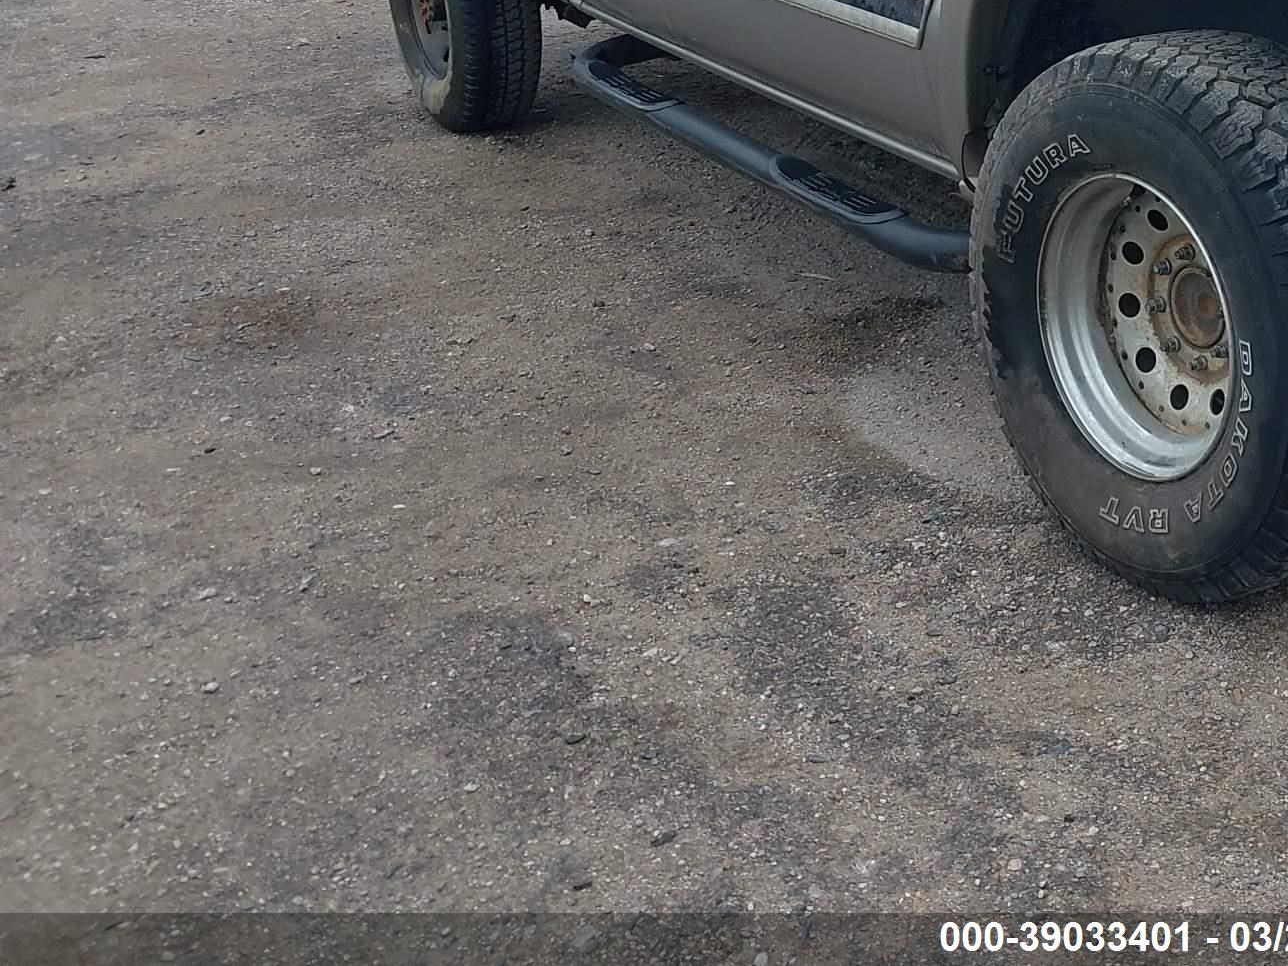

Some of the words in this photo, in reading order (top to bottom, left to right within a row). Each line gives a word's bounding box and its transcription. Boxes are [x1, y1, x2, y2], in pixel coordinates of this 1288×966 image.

[997, 133, 1092, 264] FUTURA
[1183, 338, 1253, 524] DAKOTA
[1098, 495, 1170, 535] RVT
